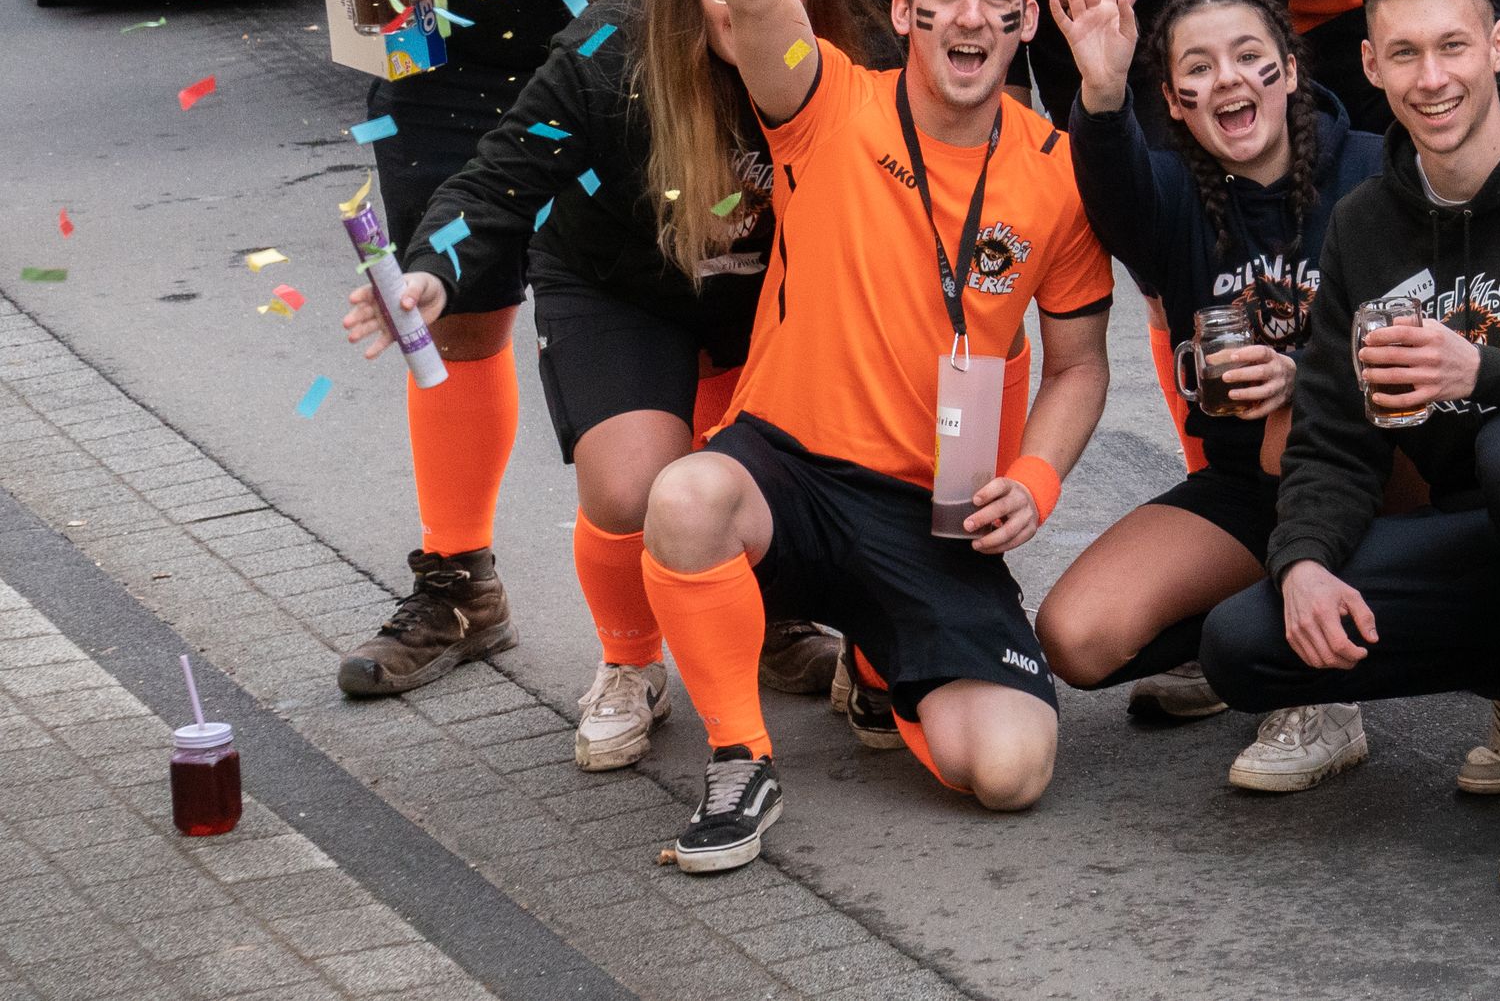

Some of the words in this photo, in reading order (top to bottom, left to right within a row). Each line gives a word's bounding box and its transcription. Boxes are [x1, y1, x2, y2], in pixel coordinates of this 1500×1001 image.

[877, 153, 918, 190] JAKO
[968, 272, 1021, 296] ERLE
[1002, 648, 1039, 675] JAKO
